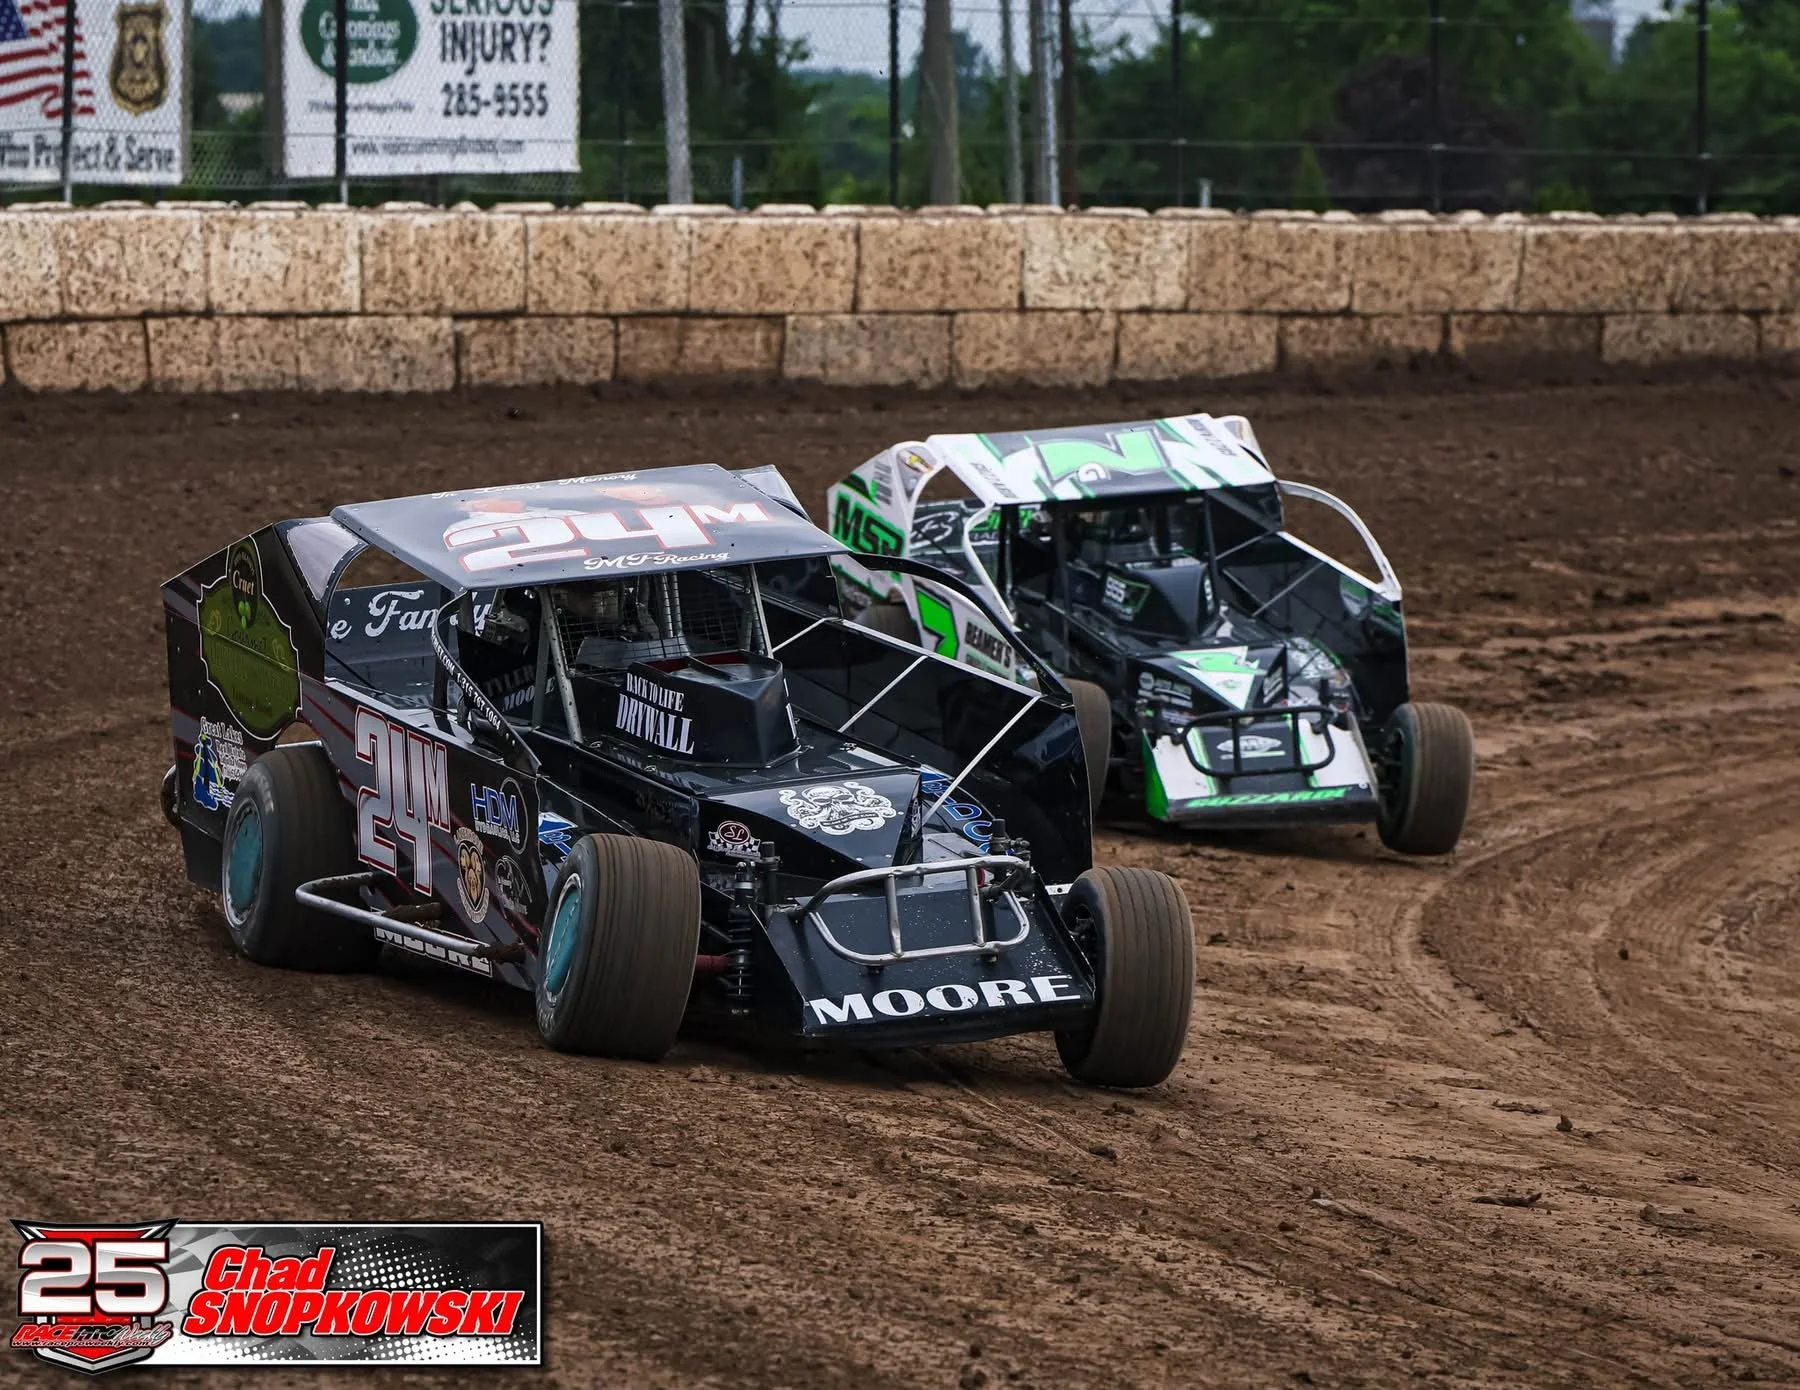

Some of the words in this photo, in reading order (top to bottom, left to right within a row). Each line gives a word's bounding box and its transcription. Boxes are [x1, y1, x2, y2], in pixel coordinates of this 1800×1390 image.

[440, 22, 551, 75] INJURY?
[441, 82, 549, 117] 285-9555
[557, 472, 638, 486] Memory
[443, 502, 774, 573] 24M
[232, 570, 254, 597] Cruet
[473, 691, 486, 712] 767
[485, 707, 501, 731] 1064
[626, 672, 649, 697] BACK
[648, 678, 659, 703] TO
[658, 687, 685, 712] LIFE
[616, 693, 695, 755] DRYWALL
[355, 704, 451, 897] 24M
[470, 783, 520, 833] HDM
[808, 974, 1082, 1025] MOORE
